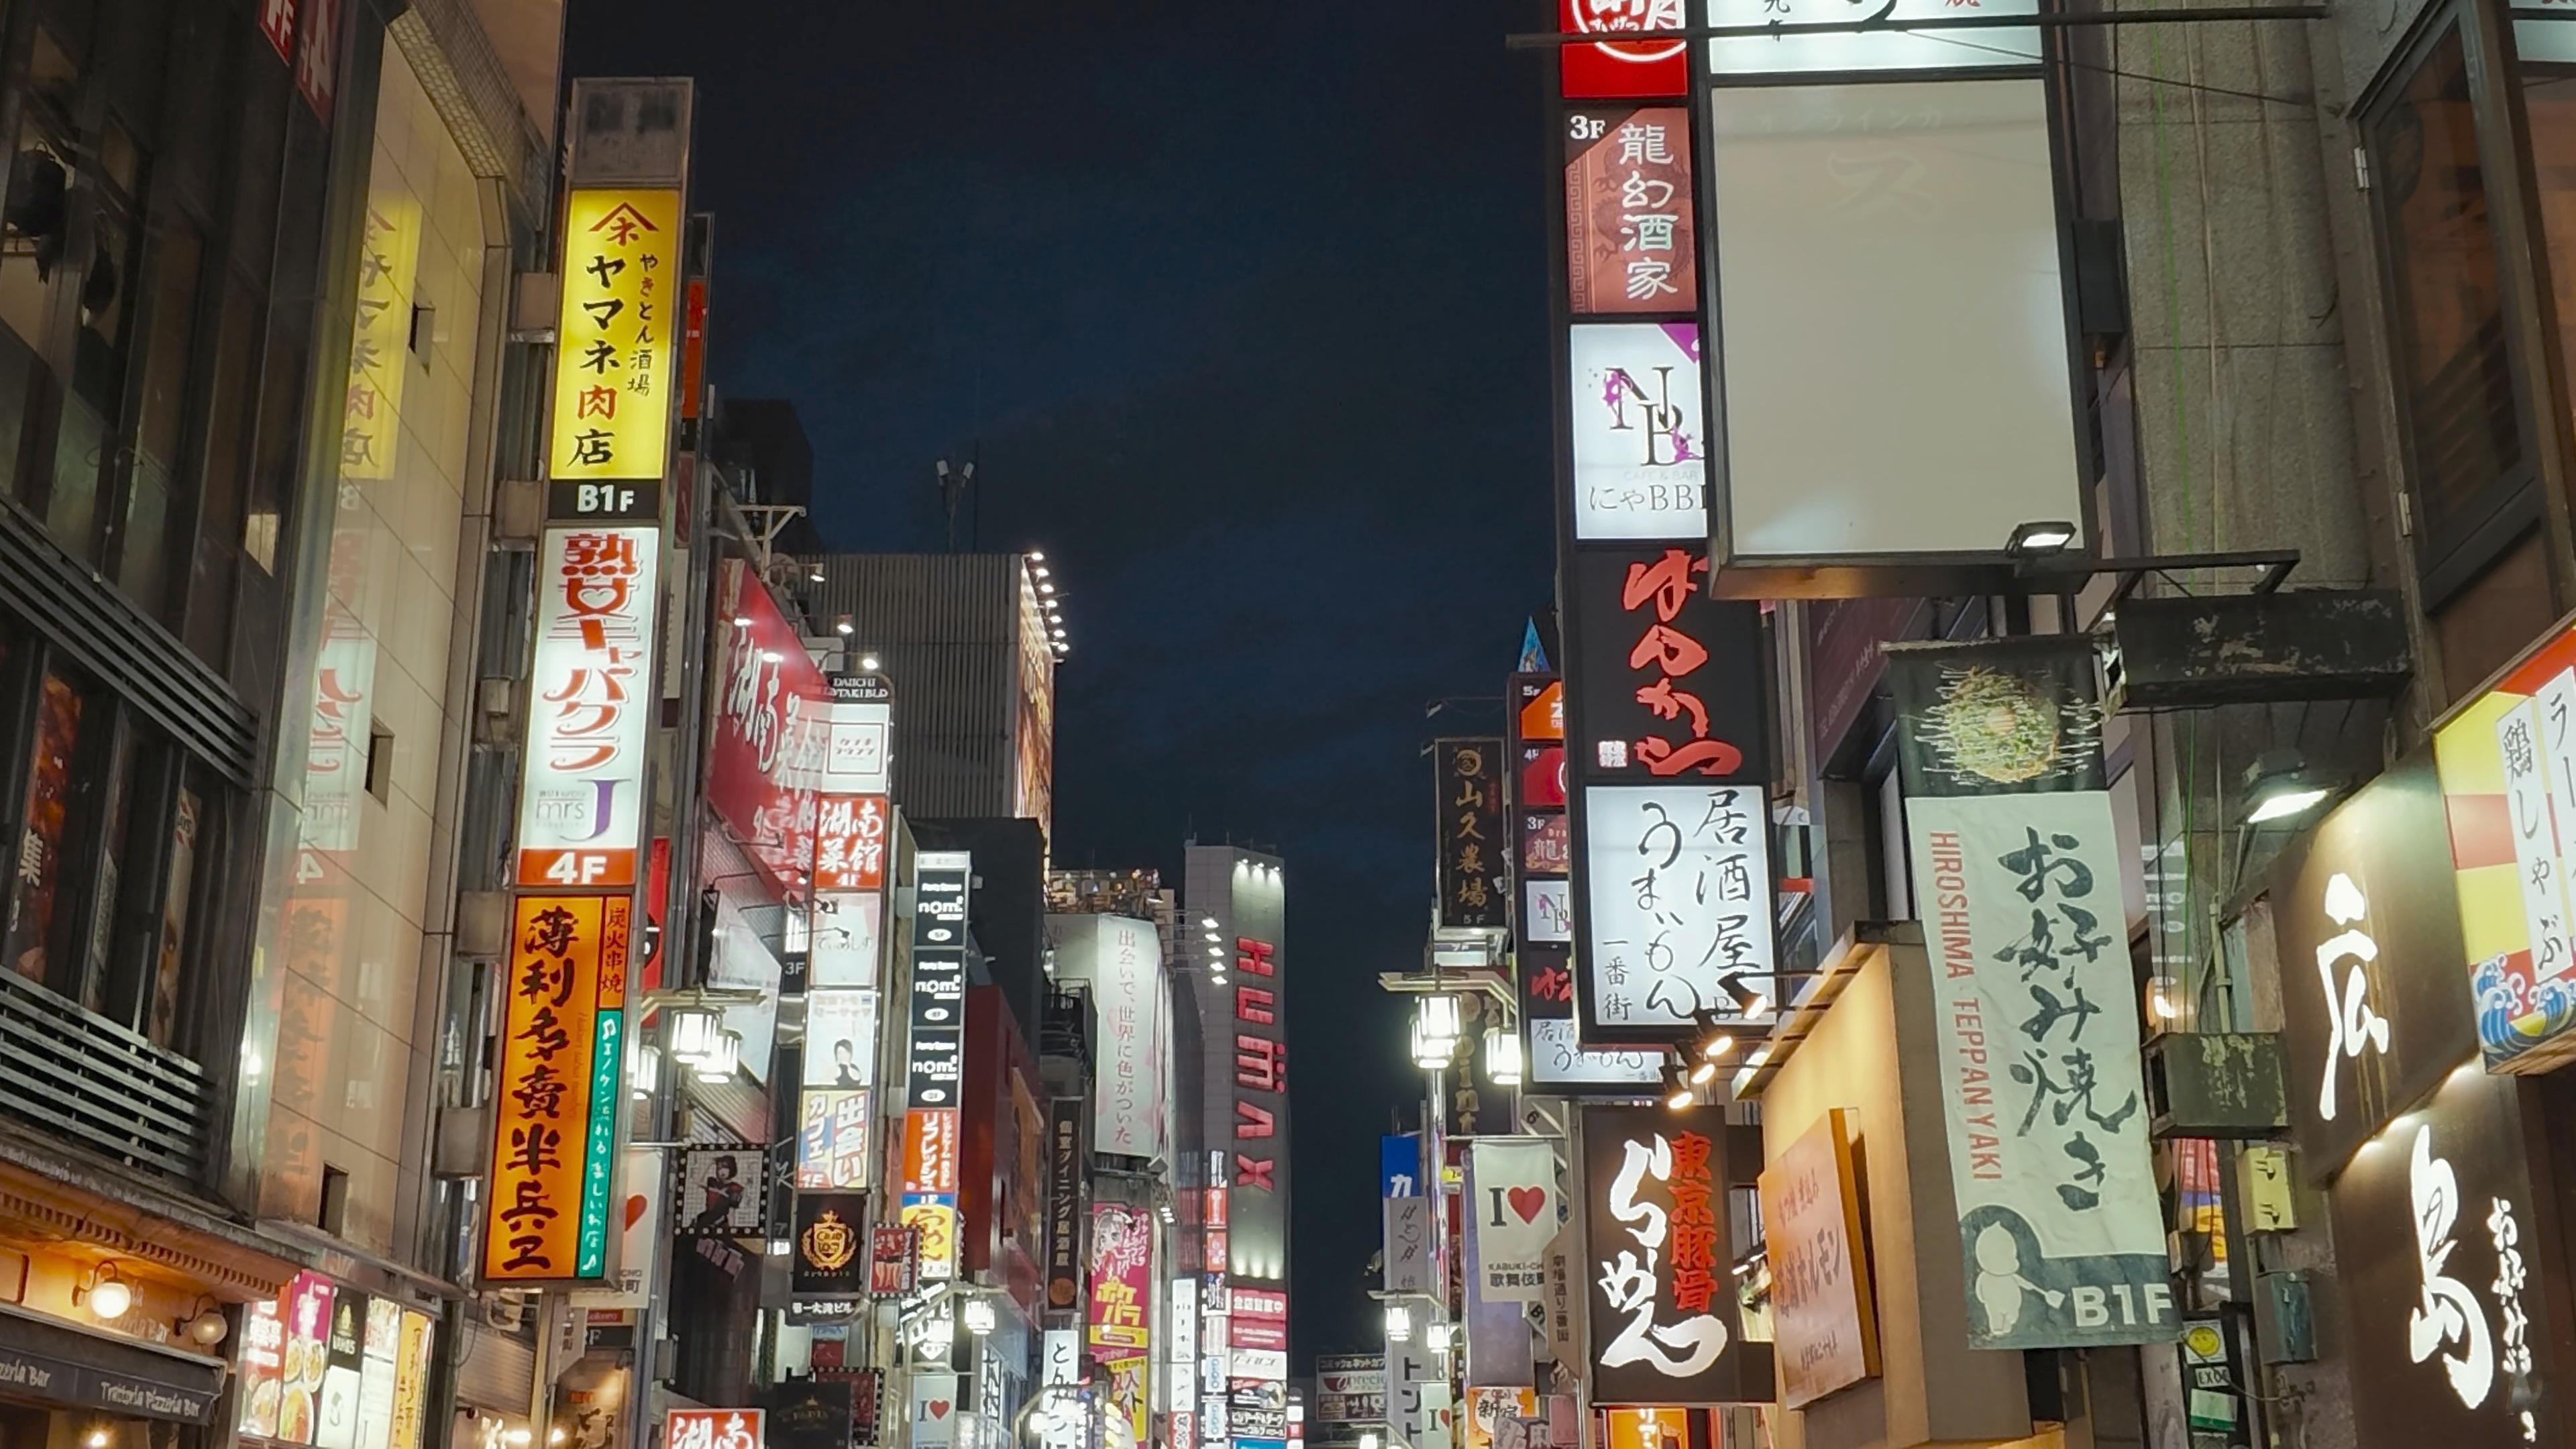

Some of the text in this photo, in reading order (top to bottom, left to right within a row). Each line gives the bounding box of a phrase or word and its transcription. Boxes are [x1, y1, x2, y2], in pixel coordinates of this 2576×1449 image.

[1570, 115, 1606, 140] 3F
[1617, 123, 1679, 300] 龍幻酒家
[567, 255, 627, 468] ヤマネ肉店
[627, 252, 658, 396] やきとん酒場
[577, 484, 635, 514] B1F
[536, 800, 584, 819] mrs
[1454, 780, 1487, 912] 山久農場
[546, 851, 607, 885] 4F
[1694, 788, 1761, 971] 居酒屋
[1929, 830, 1975, 979] HIROSHIMA
[784, 962, 806, 975] 3F
[1602, 940, 1633, 1020] 一番街
[1237, 936, 1287, 1192] HUMAX
[833, 1095, 866, 1187] 出会い
[1489, 1187, 1507, 1226] I
[1668, 1130, 1719, 1313] 東京豚骨
[1599, 1132, 1729, 1379] らめん
[2072, 1283, 2174, 1327] B1F
[918, 1400, 930, 1423] I
[1428, 1409, 1438, 1431] I
